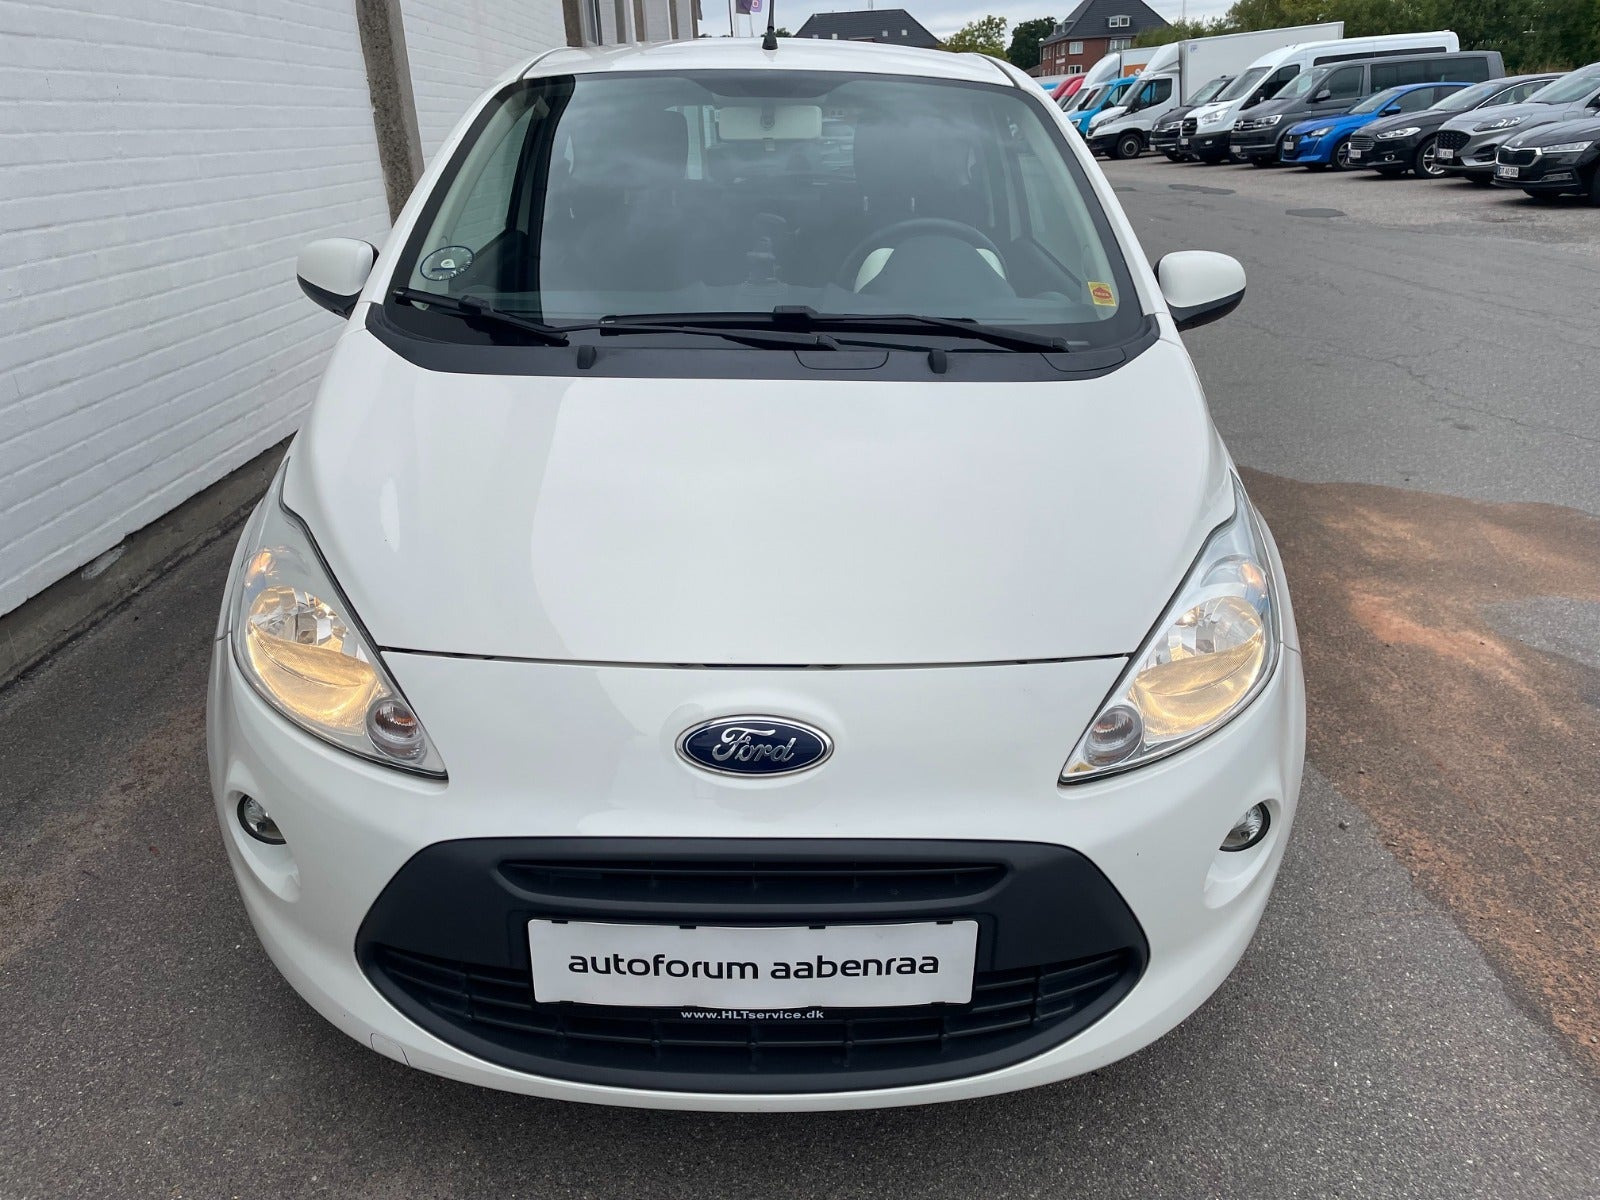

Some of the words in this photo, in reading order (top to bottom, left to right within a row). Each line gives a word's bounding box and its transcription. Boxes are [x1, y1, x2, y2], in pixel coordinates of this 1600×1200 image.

[712, 727, 797, 762] Ford
[568, 953, 759, 980] autoforum
[770, 954, 939, 980] aabenraa
[680, 1010, 825, 1019] www.HLTservice.dk
